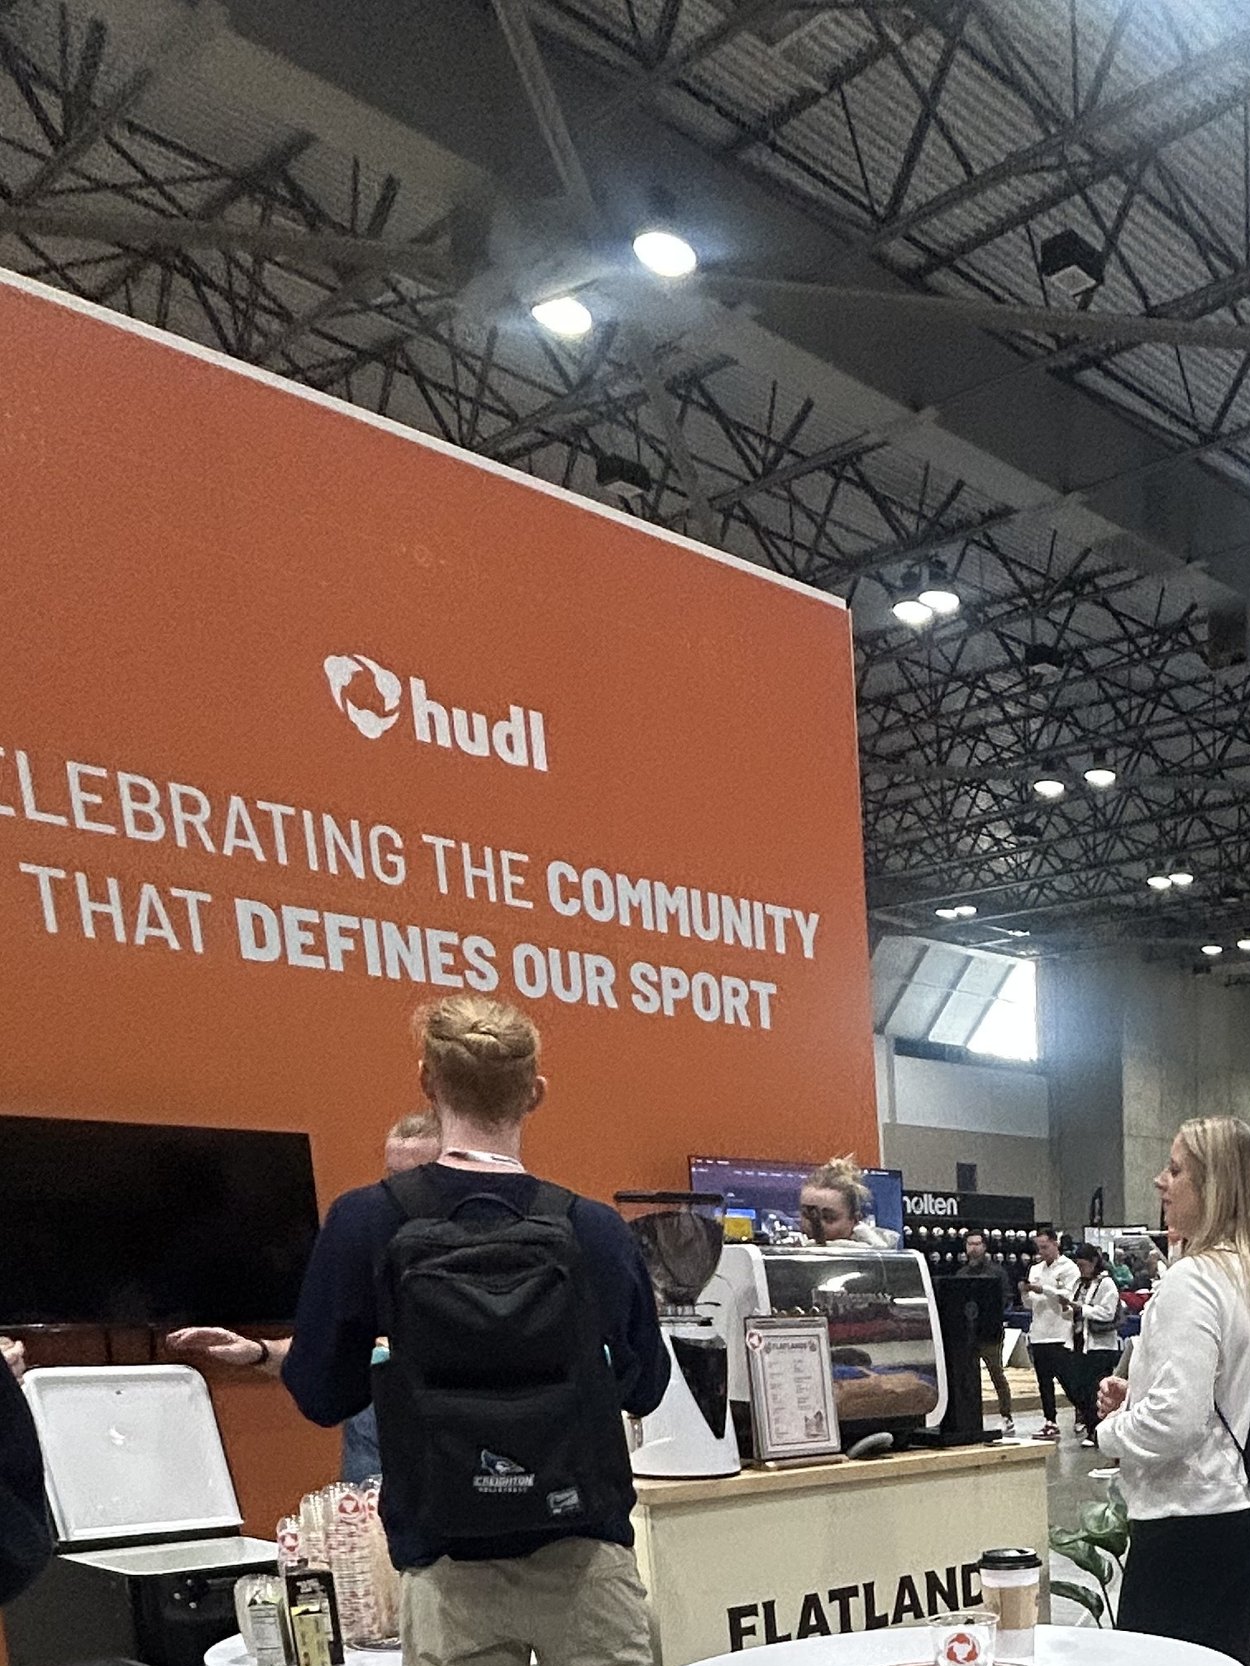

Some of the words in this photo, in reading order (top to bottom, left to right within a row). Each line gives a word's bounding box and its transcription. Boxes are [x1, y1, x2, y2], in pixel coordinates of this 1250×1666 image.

[409, 676, 548, 772] hudl
[0, 746, 406, 885] LEBRATING
[421, 833, 533, 909] THE
[547, 860, 820, 960] COMMUNITY
[18, 861, 212, 954] THAT
[234, 897, 499, 992] DEFINES
[513, 942, 618, 1009] OUR
[629, 960, 777, 1030] SPORT
